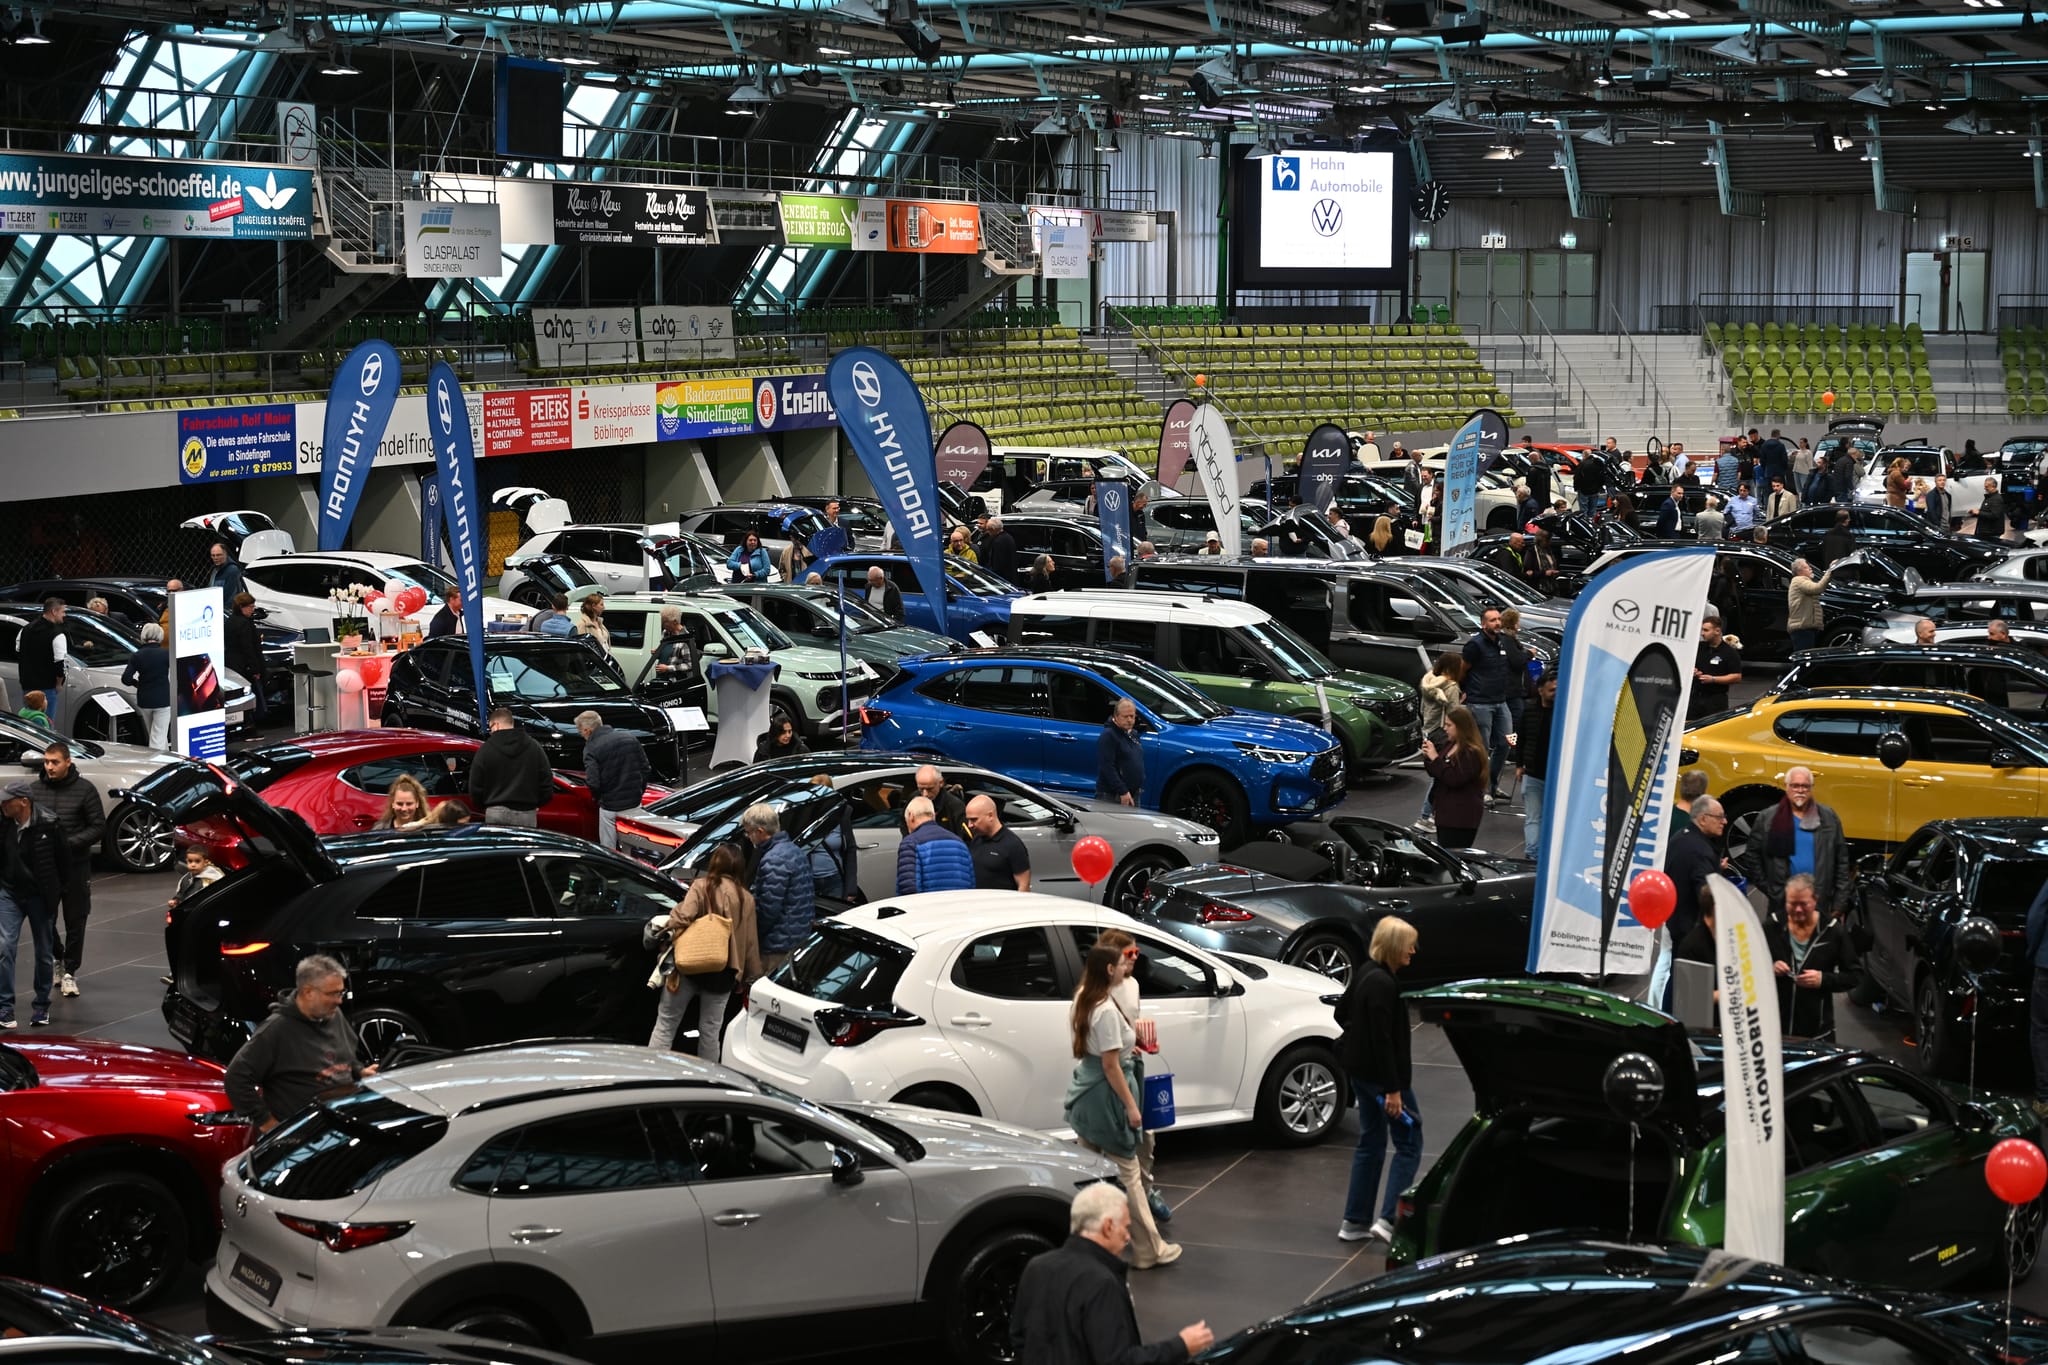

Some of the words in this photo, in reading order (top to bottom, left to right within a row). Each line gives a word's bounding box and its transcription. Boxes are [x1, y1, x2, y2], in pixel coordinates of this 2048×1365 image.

[1310, 157, 1345, 171] Hahn
[1310, 179, 1383, 194] Automobile
[784, 204, 818, 219] ENERGIE
[237, 216, 271, 225] JUNGEILGES
[278, 216, 306, 226] SCHÖFFEL
[555, 218, 576, 228] Festwirte
[577, 220, 585, 229] auf
[585, 220, 594, 229] dem
[594, 221, 609, 229] Wasen
[634, 221, 655, 231] Festwirte
[662, 223, 671, 232] dem
[671, 224, 684, 232] Wasen
[785, 221, 815, 235] DEINEN
[816, 222, 846, 236] ERFOLG
[579, 232, 613, 243] Getränkehandel
[613, 233, 622, 243] und
[622, 234, 633, 243] mehr
[1484, 237, 1489, 245] J
[1497, 237, 1503, 245] H
[1964, 237, 1972, 245] G
[423, 245, 480, 260] GLASPALAST
[423, 263, 462, 273] SINDELFINGEN
[685, 384, 750, 403] Badezentrum
[491, 397, 516, 407] SCHROTT
[530, 394, 570, 421] PETERS
[492, 407, 516, 417] METALLE
[594, 404, 651, 421] Kreissparkasse
[686, 403, 749, 424] Sindelfingen
[183, 416, 239, 431] Fahrschule
[242, 414, 262, 427] Rolf
[264, 412, 292, 426] Maier
[492, 418, 521, 428] ALTPAPIER
[206, 437, 217, 447] Die
[218, 437, 236, 447] etwas
[237, 434, 257, 446] andere
[258, 431, 291, 444] Fahrschule
[594, 425, 634, 441] Böblingen
[492, 440, 512, 450] DIENST
[228, 452, 235, 461] in
[221, 468, 237, 476] sonst
[261, 461, 292, 473] 879933
[869, 411, 933, 540] HYUNDAI
[948, 468, 968, 480] ahg
[1316, 473, 1333, 486] ahg
[445, 441, 479, 603] HYUNDAI
[1605, 621, 1641, 635] MAZDA
[1651, 605, 1693, 639] FIAT
[180, 625, 212, 641] MEILING
[1551, 930, 1590, 943] Böblingen
[1938, 1244, 1958, 1262] FORUM
